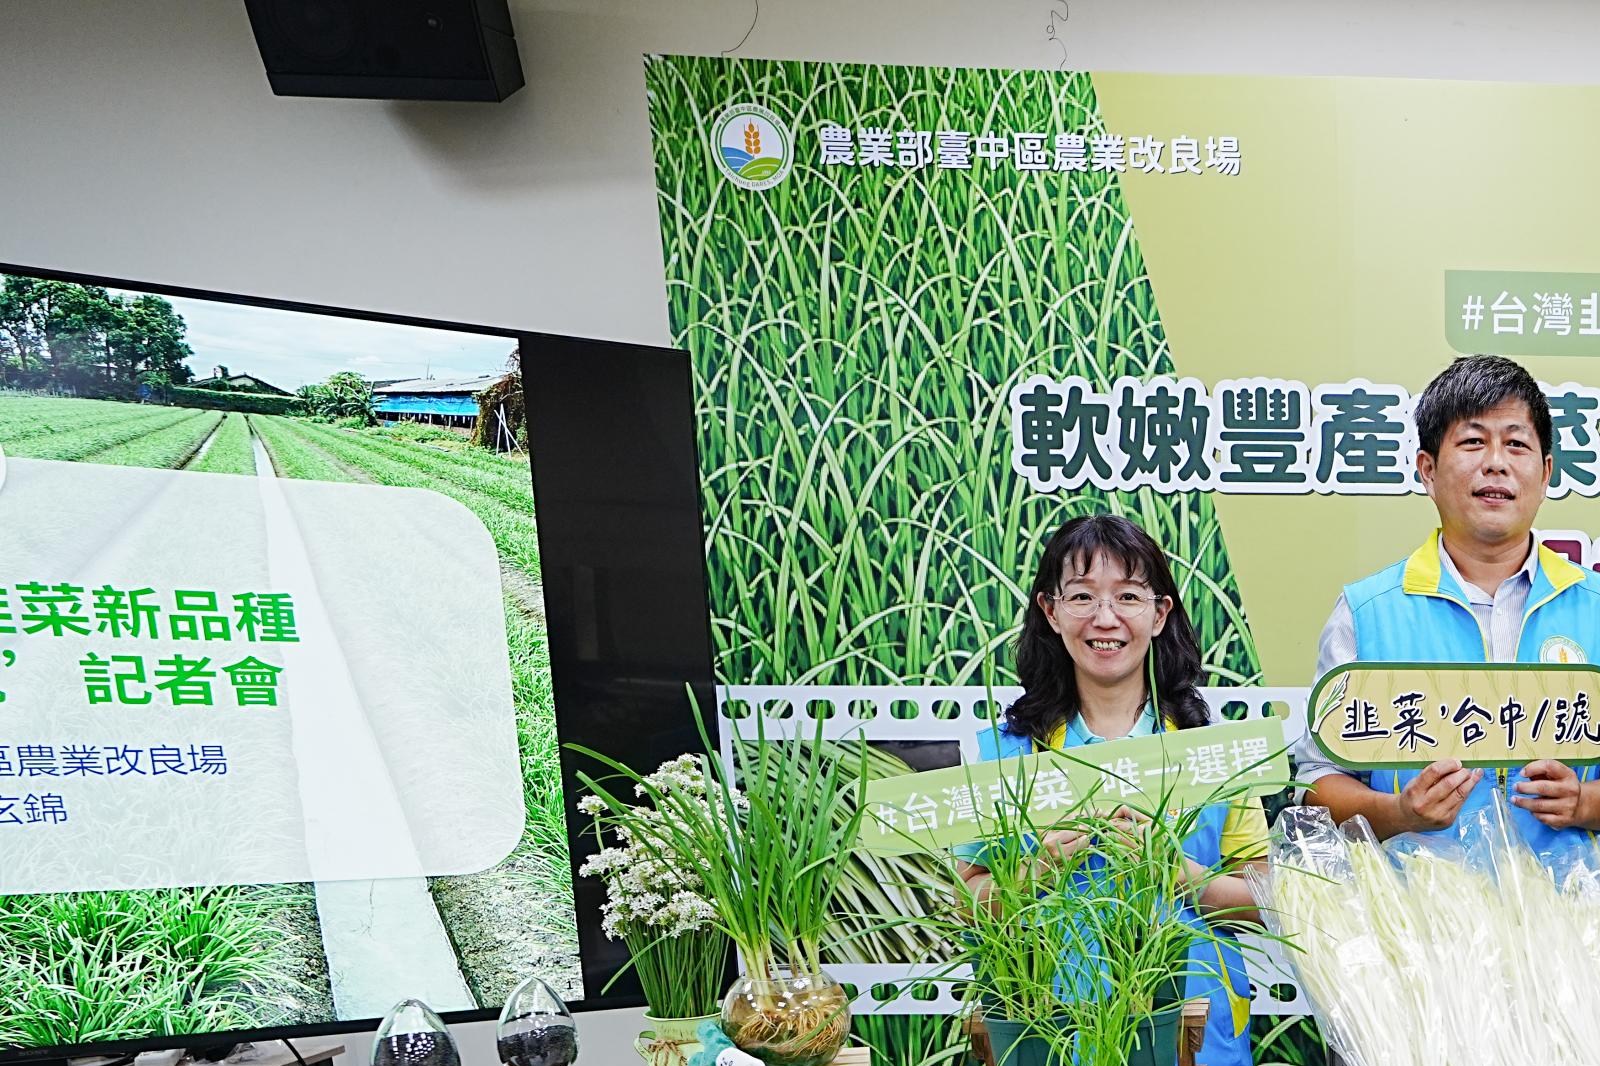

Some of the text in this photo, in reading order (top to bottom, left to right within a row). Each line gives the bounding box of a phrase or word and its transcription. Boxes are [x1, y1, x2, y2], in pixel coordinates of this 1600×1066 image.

[819, 126, 1242, 177] 農業部臺中區農業改良場
[79, 652, 284, 707] 記者會
[566, 980, 574, 990] 1
